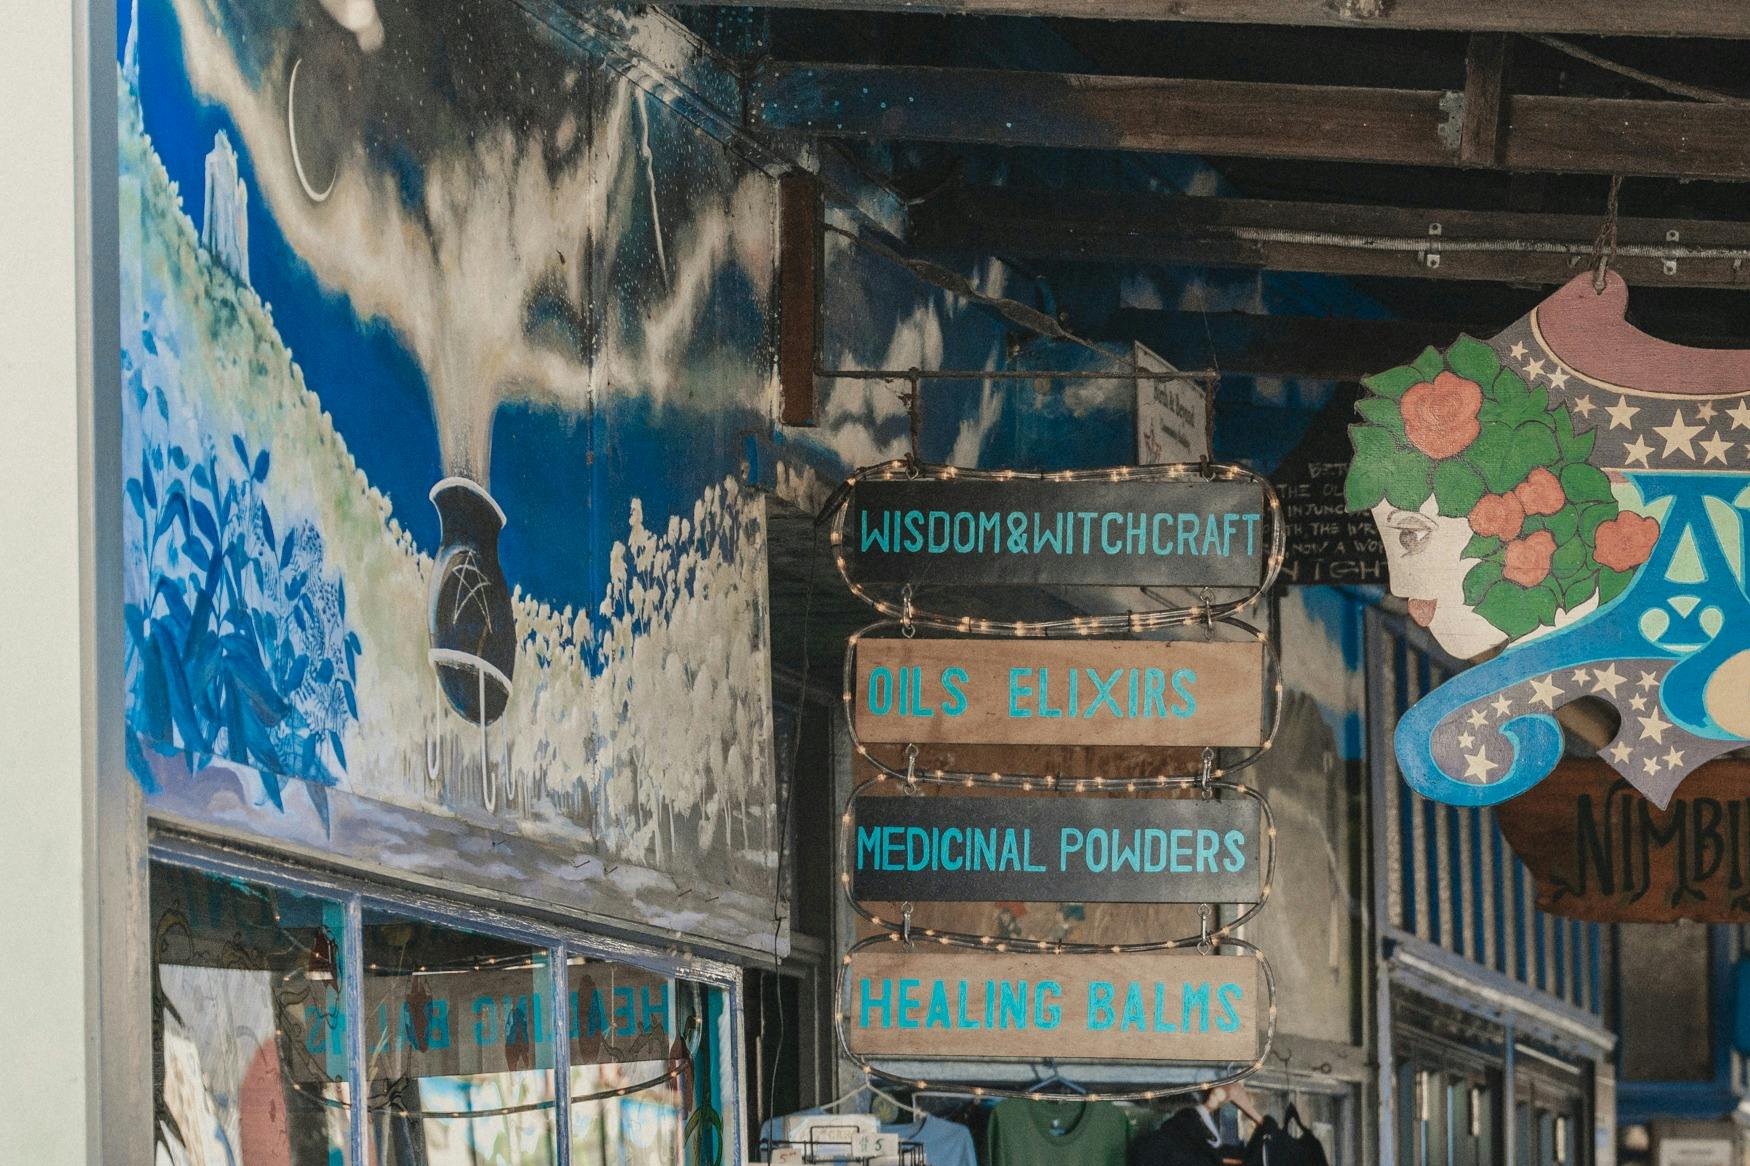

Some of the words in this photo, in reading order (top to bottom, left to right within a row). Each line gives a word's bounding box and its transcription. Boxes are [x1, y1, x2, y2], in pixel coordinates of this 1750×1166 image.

[861, 509, 1261, 557] WISDOM&WITCHCRAFT
[868, 667, 970, 718] OILS
[1008, 667, 1198, 719] ELIXIRS
[857, 825, 1047, 873] MEDICINAL
[1060, 827, 1246, 874] POWDERS
[859, 978, 1063, 1030] HEALING
[1087, 981, 1244, 1034] BALMS
